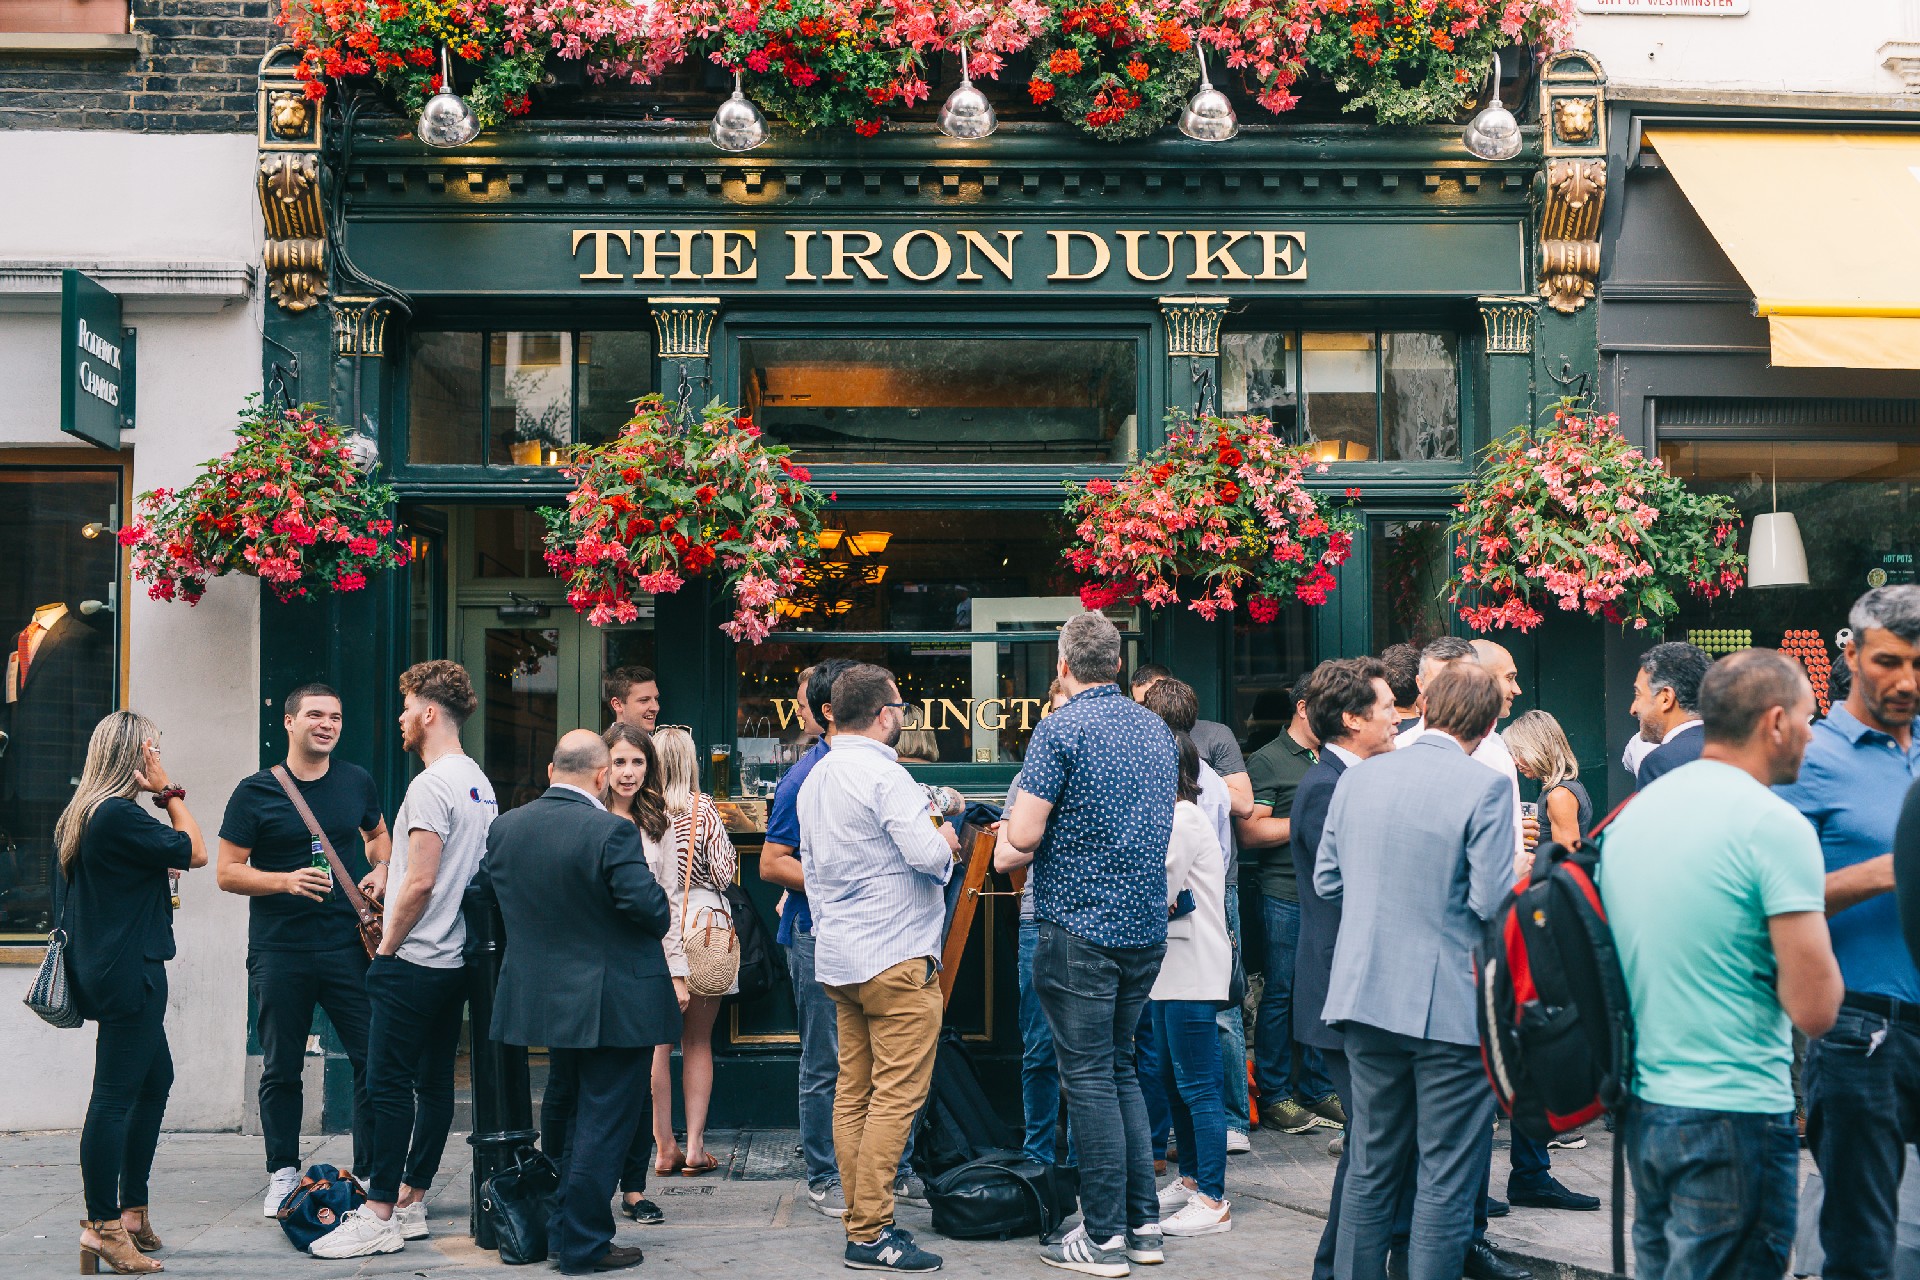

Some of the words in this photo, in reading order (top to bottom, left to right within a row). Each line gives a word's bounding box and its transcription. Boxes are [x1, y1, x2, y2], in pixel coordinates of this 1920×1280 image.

[572, 229, 757, 279] THE
[785, 229, 1023, 281] IRON
[1046, 230, 1308, 281] DUKE
[80, 361, 119, 407] CHARLES
[1883, 554, 1896, 563] HOT
[1896, 554, 1913, 563] POTS
[769, 698, 1052, 731] WLINGT
